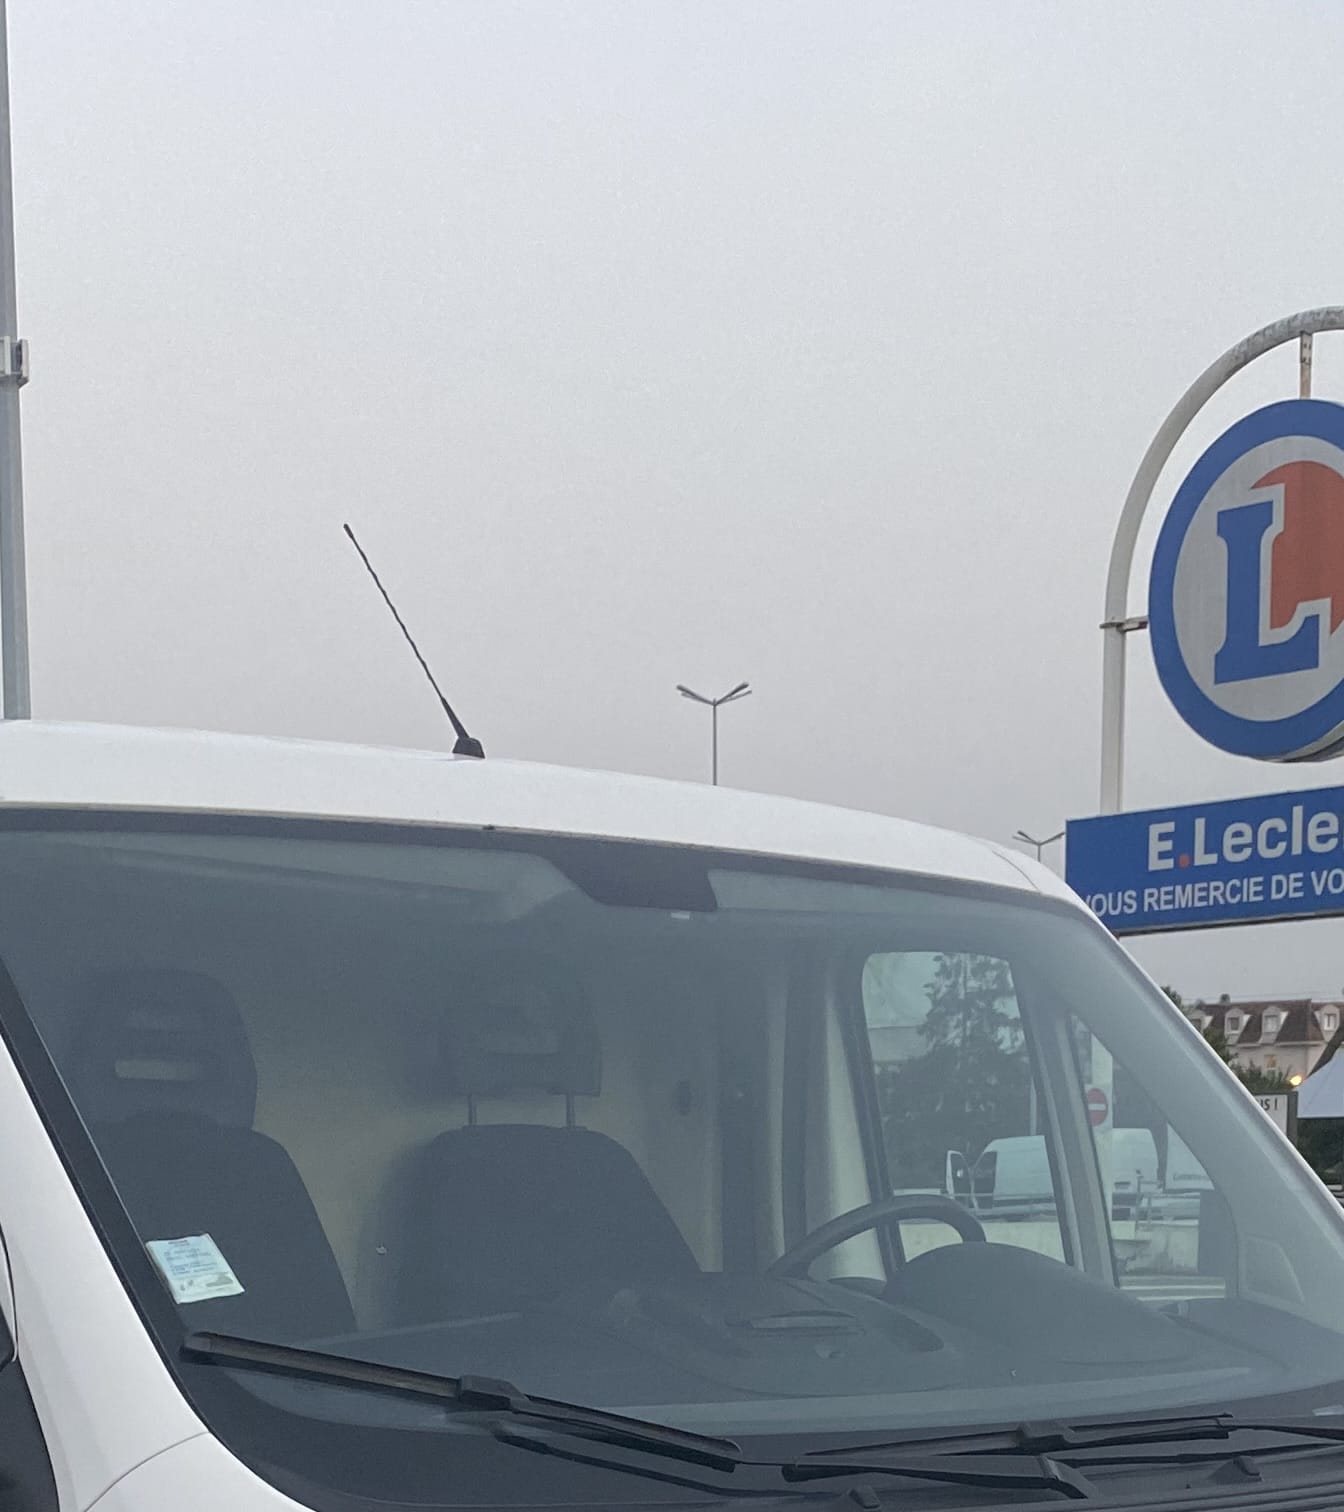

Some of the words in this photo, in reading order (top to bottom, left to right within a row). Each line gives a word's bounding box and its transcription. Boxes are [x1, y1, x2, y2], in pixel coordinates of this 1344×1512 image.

[1086, 889, 1138, 918] OUS
[1143, 876, 1262, 912] REMERCIE
[1271, 871, 1305, 898] DE
